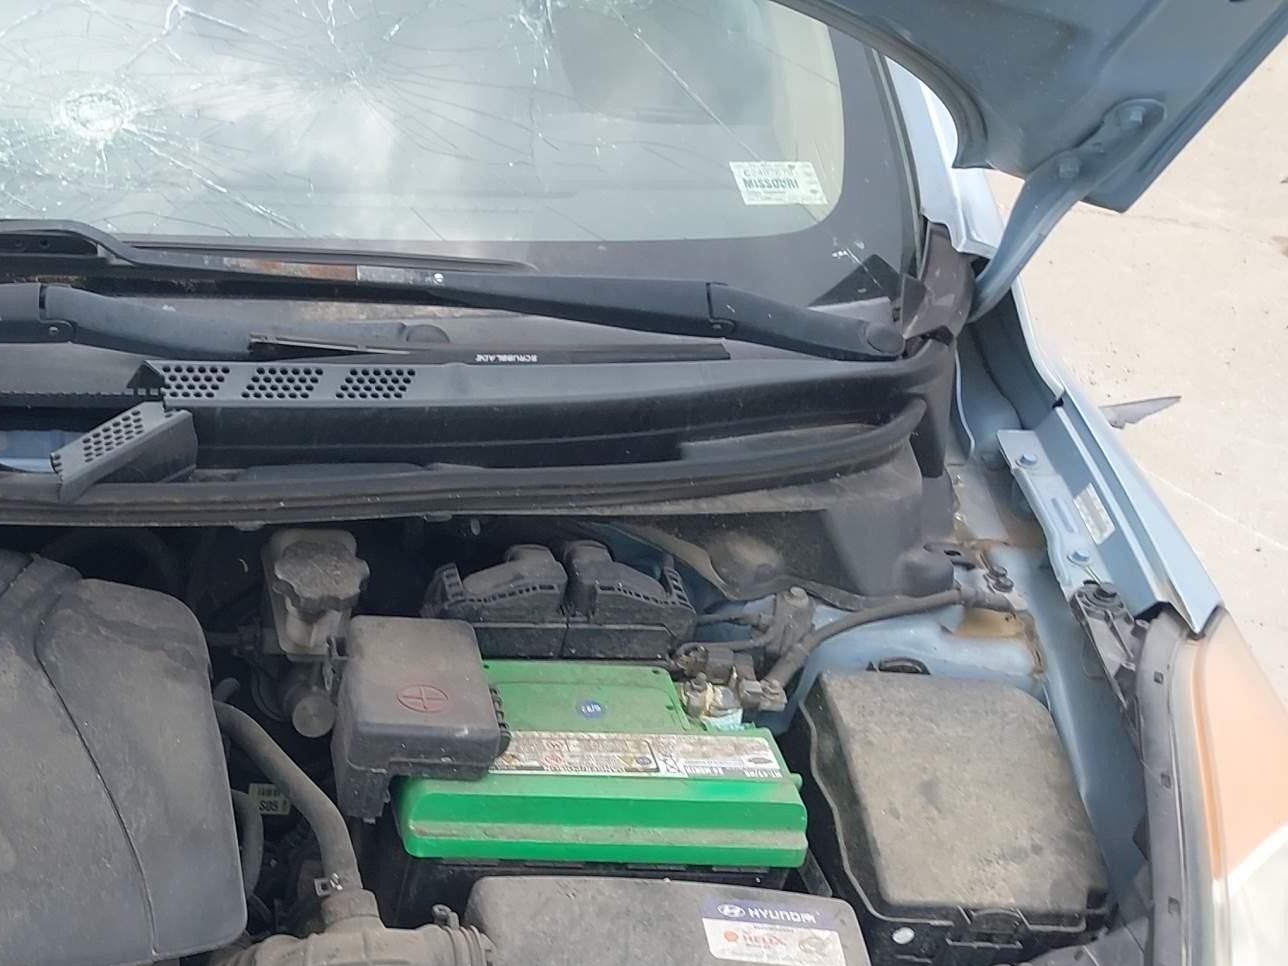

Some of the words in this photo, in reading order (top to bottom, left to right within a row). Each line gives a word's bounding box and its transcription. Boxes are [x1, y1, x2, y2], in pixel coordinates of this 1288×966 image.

[743, 178, 799, 190] MISSOURI
[475, 353, 538, 363] SCRUBBLADE
[747, 907, 816, 924] HYUNDAI
